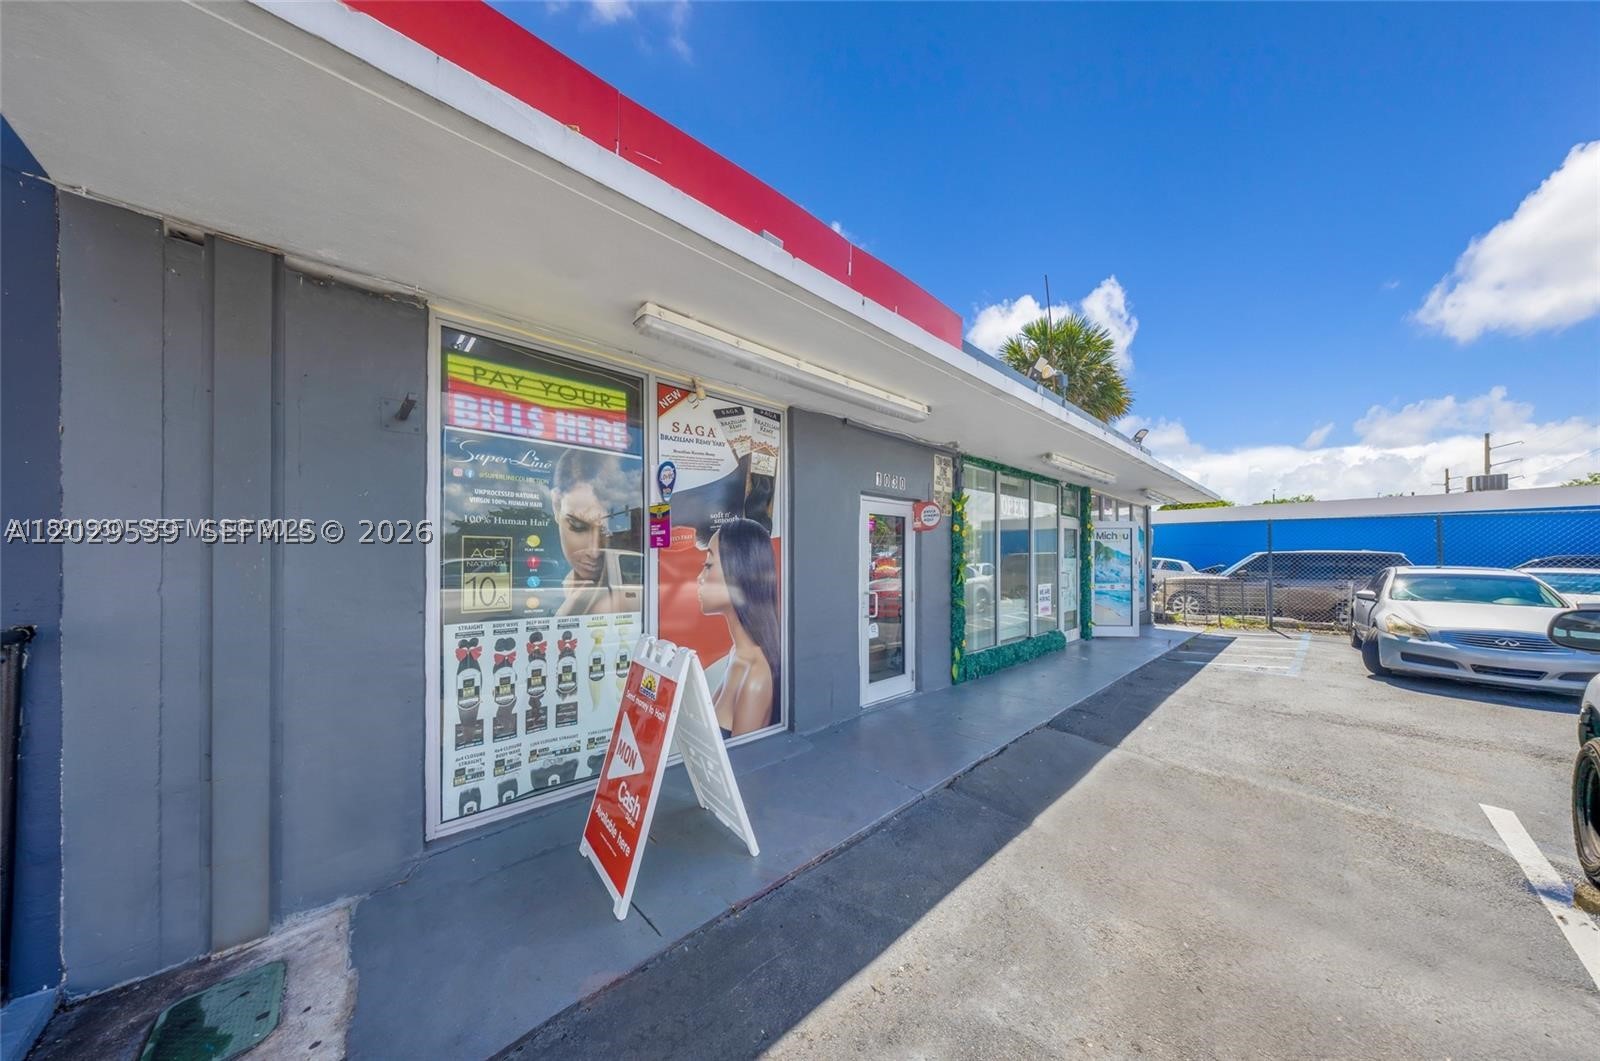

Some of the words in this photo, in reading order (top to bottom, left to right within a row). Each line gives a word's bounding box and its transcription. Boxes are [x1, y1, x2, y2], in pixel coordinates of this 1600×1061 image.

[473, 366, 525, 390] PAY
[540, 380, 611, 408] YOUR
[659, 389, 681, 408] NEW
[454, 393, 544, 437] BILLS
[555, 410, 629, 449] HERE
[672, 421, 716, 438] SAGA
[660, 433, 694, 443] BRAZILIAN
[474, 488, 515, 498] UNPROCESSED
[464, 514, 491, 524] 100%
[494, 516, 527, 526] Human
[530, 518, 550, 527] Hair
[470, 548, 505, 558] ACE
[617, 739, 638, 770] MON
[618, 781, 640, 821] Cash
[617, 832, 631, 857] here
